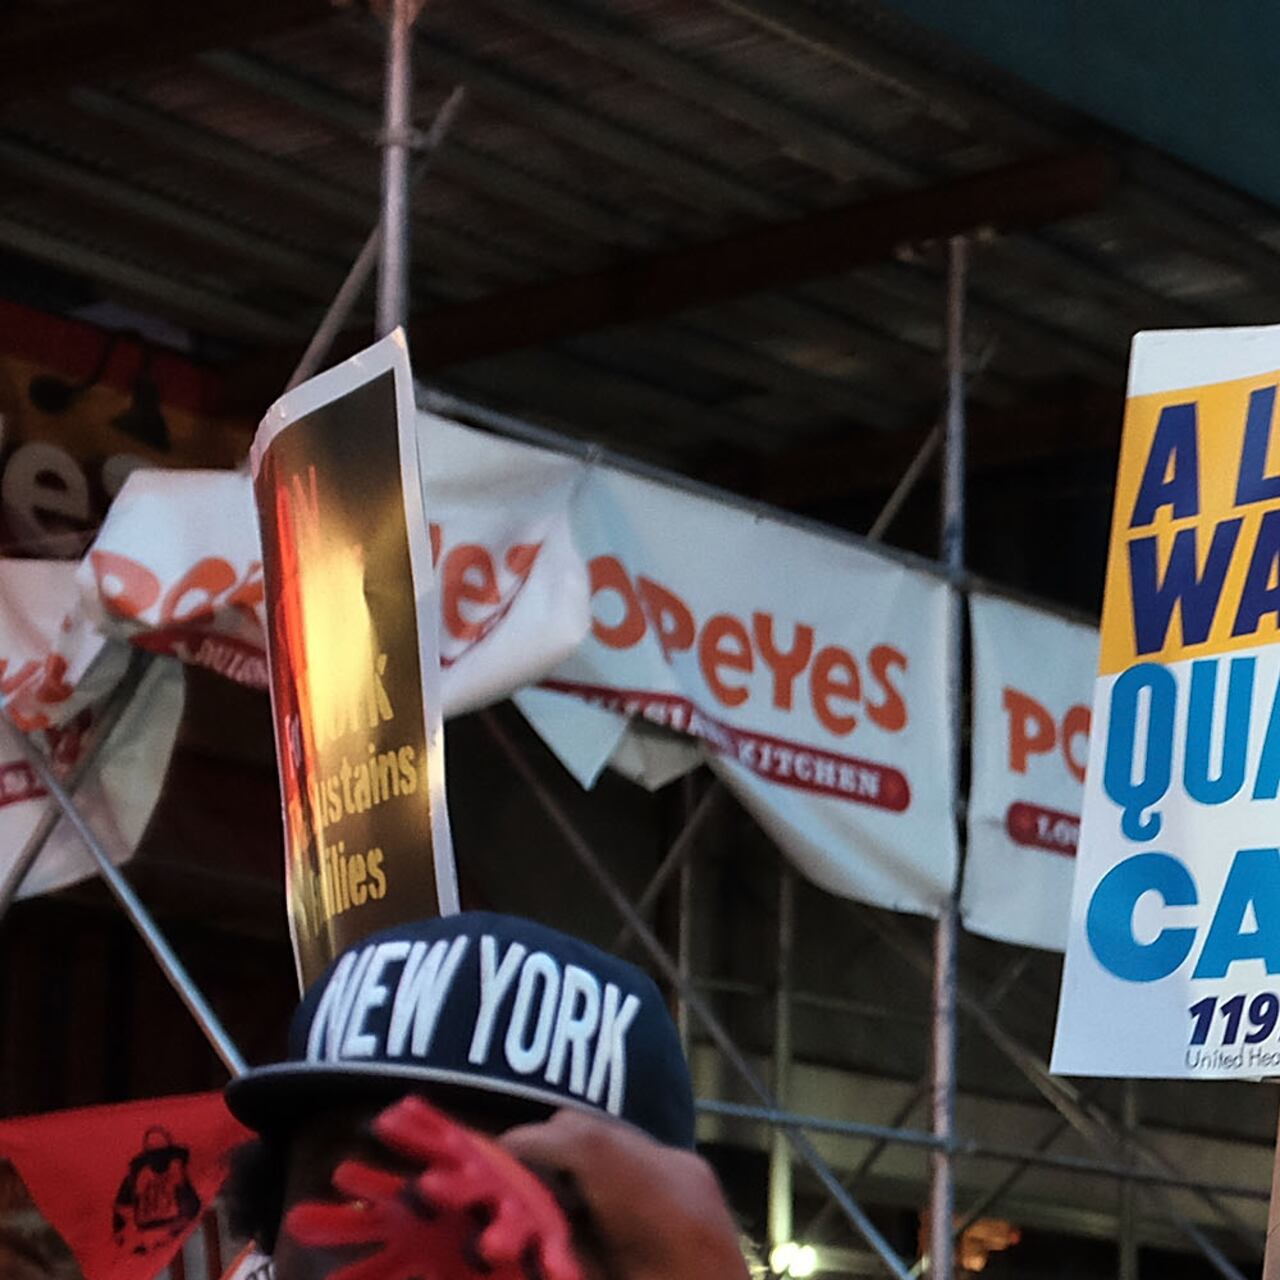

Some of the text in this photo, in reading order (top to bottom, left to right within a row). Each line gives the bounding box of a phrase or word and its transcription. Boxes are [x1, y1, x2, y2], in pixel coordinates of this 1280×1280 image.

[1129, 402, 1199, 529] A
[738, 741, 881, 798] KITCHEN
[305, 934, 641, 1117] NEW YORK
[1185, 1048, 1243, 1071] United
